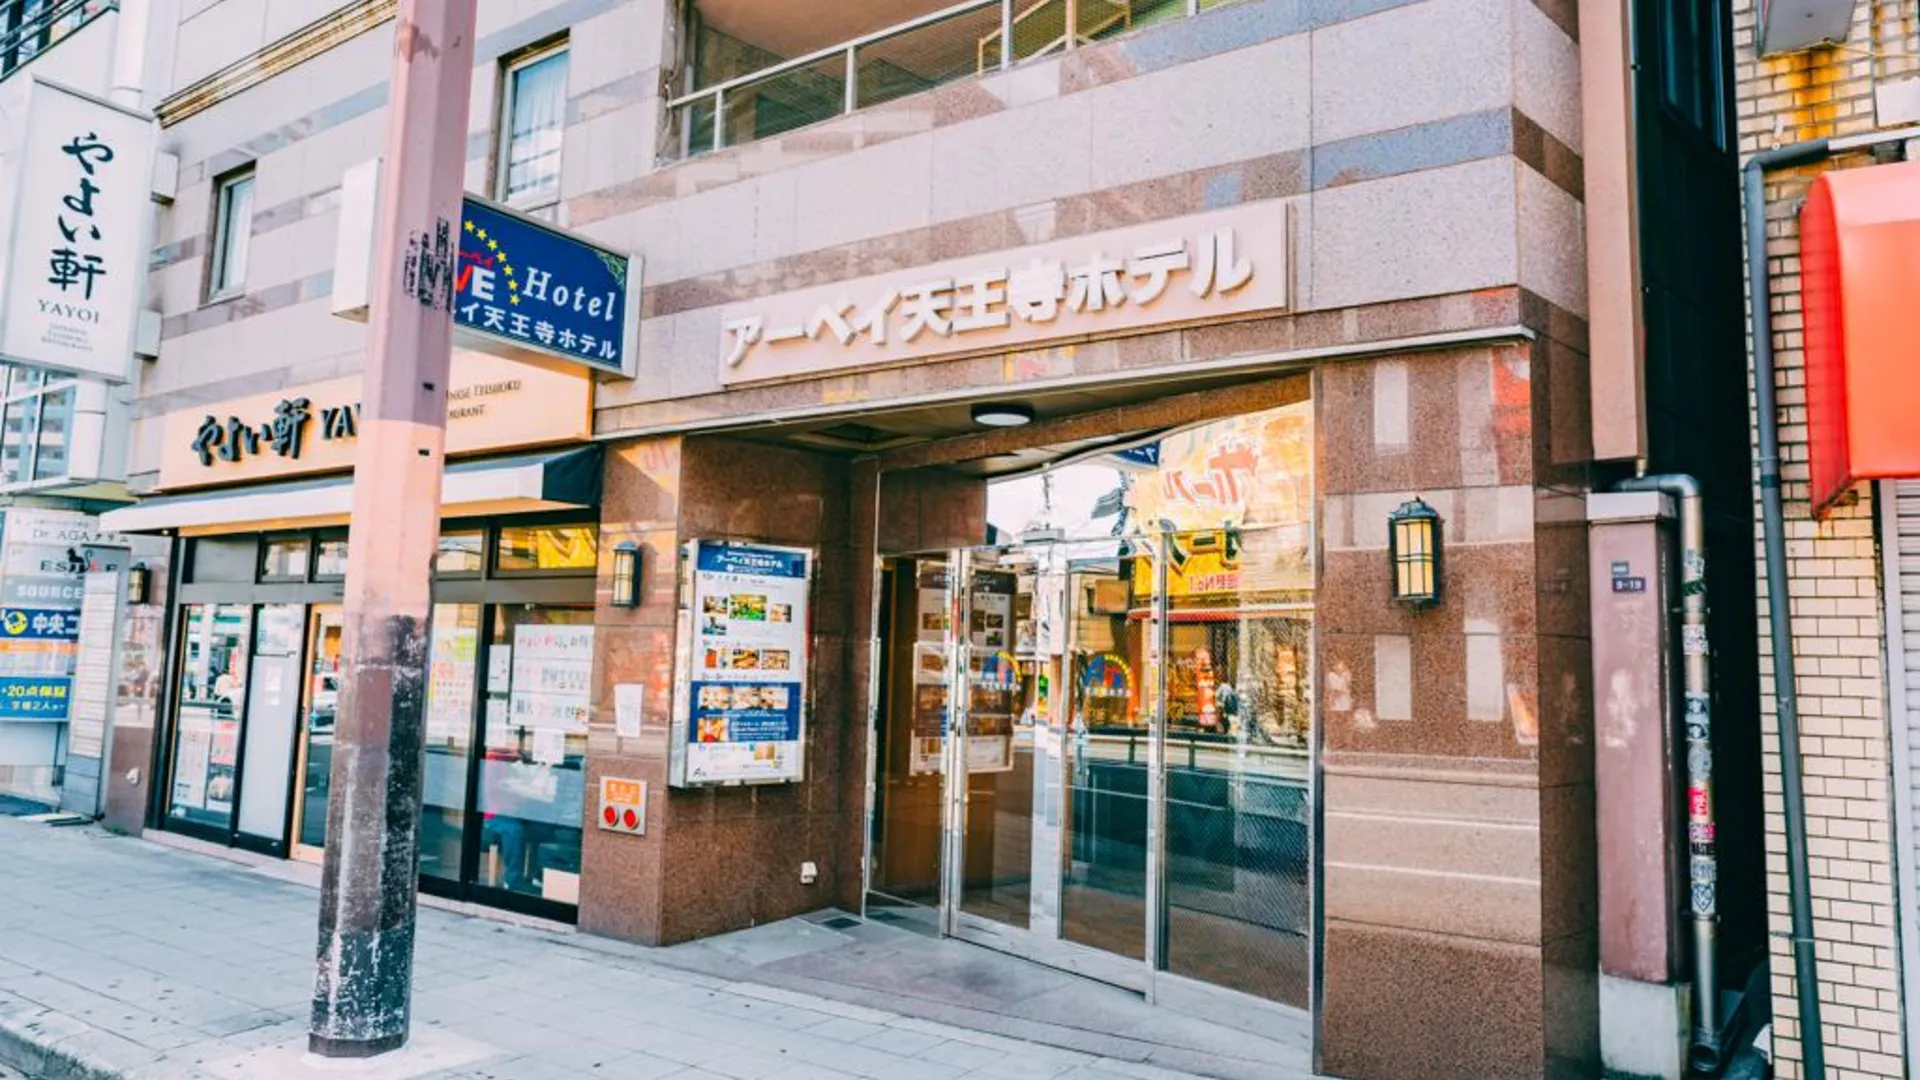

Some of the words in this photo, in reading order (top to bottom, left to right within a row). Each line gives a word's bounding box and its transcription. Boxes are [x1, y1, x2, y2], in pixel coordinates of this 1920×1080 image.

[48, 132, 114, 300] やよい軒
[39, 299, 99, 324] YAYOI
[522, 266, 617, 322] Hotel
[724, 227, 1254, 367] アーベイ天王寺ホテル
[452, 302, 617, 360] イ天王寺ホテル
[192, 397, 312, 468] やよい軒
[321, 403, 363, 441] YA
